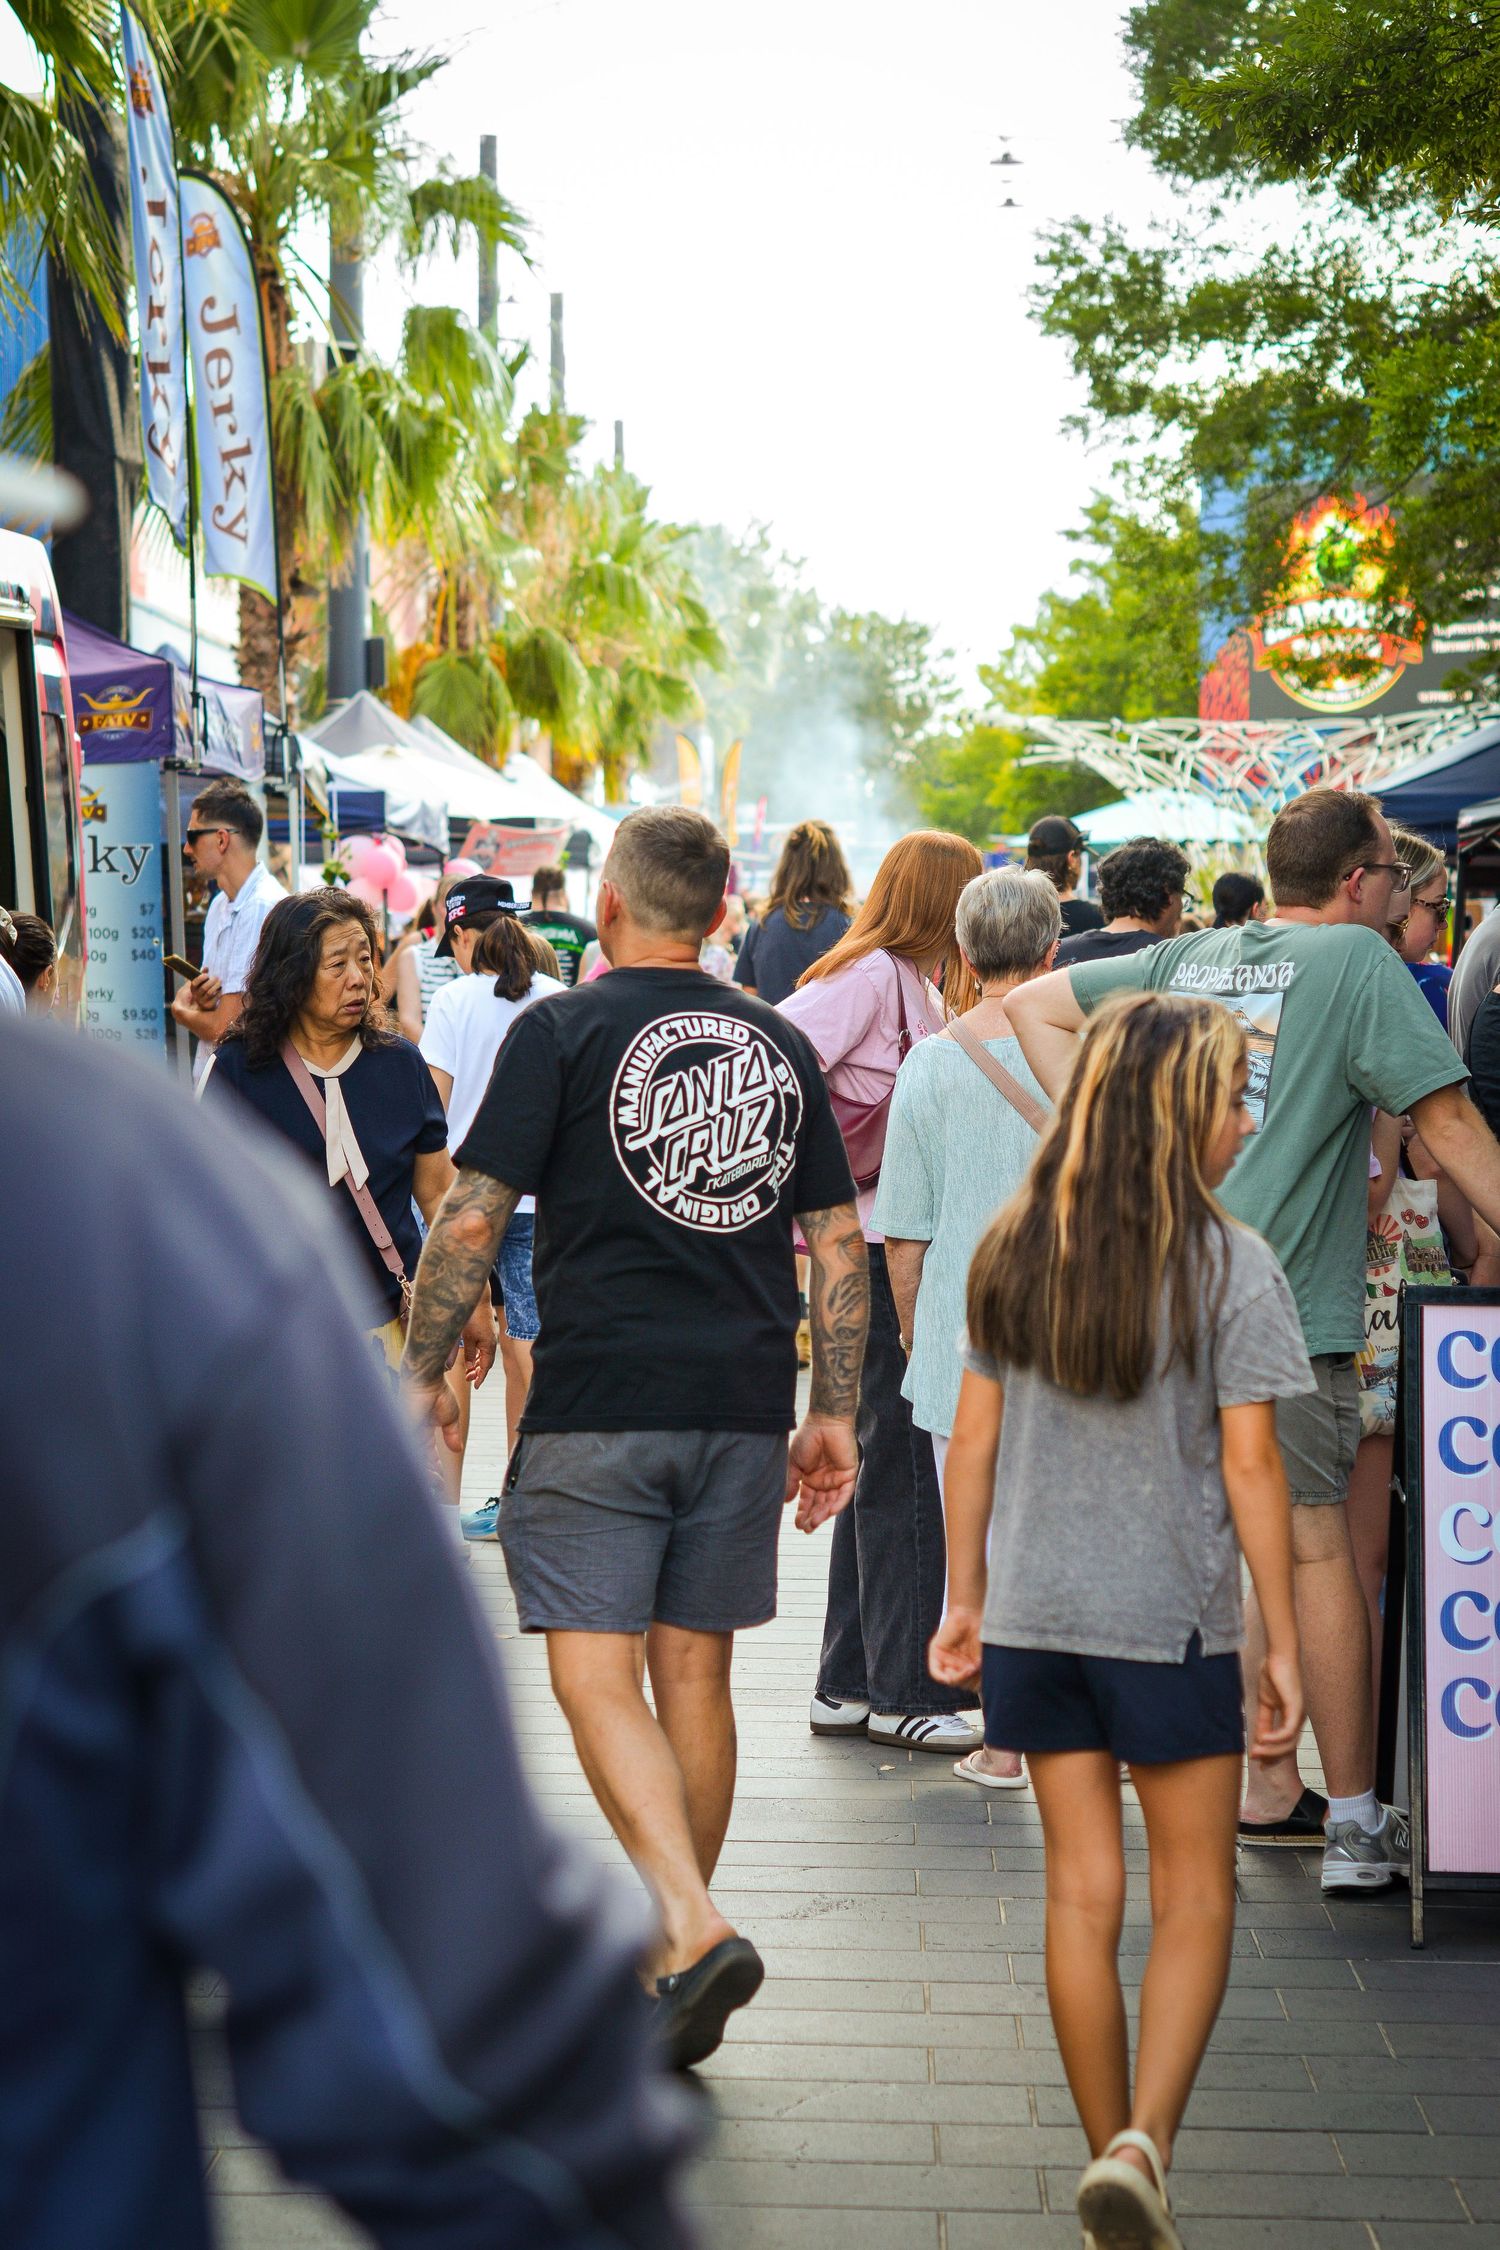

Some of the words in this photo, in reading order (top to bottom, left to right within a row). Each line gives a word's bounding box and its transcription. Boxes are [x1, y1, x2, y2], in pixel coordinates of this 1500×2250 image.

[200, 296, 253, 547] Jerky
[87, 835, 152, 885] ky
[139, 903, 155, 916] $7
[448, 905, 466, 922] KFC
[88, 928, 119, 941] 100g
[131, 927, 155, 940] $20
[87, 951, 107, 964] 0g
[131, 950, 156, 962] $40
[1169, 961, 1295, 991] PROPAANDA
[87, 988, 114, 1002] erky
[122, 1007, 158, 1021] $9.50
[91, 1028, 122, 1041] 100g
[618, 1017, 750, 1128] MANUFACTURED
[773, 1062, 797, 1097] BY
[624, 1040, 775, 1151] SANTA
[661, 1094, 776, 1188] CRUZ
[702, 1149, 775, 1193] SKATEBOARDS
[644, 1165, 761, 1225] ORIGINAL
